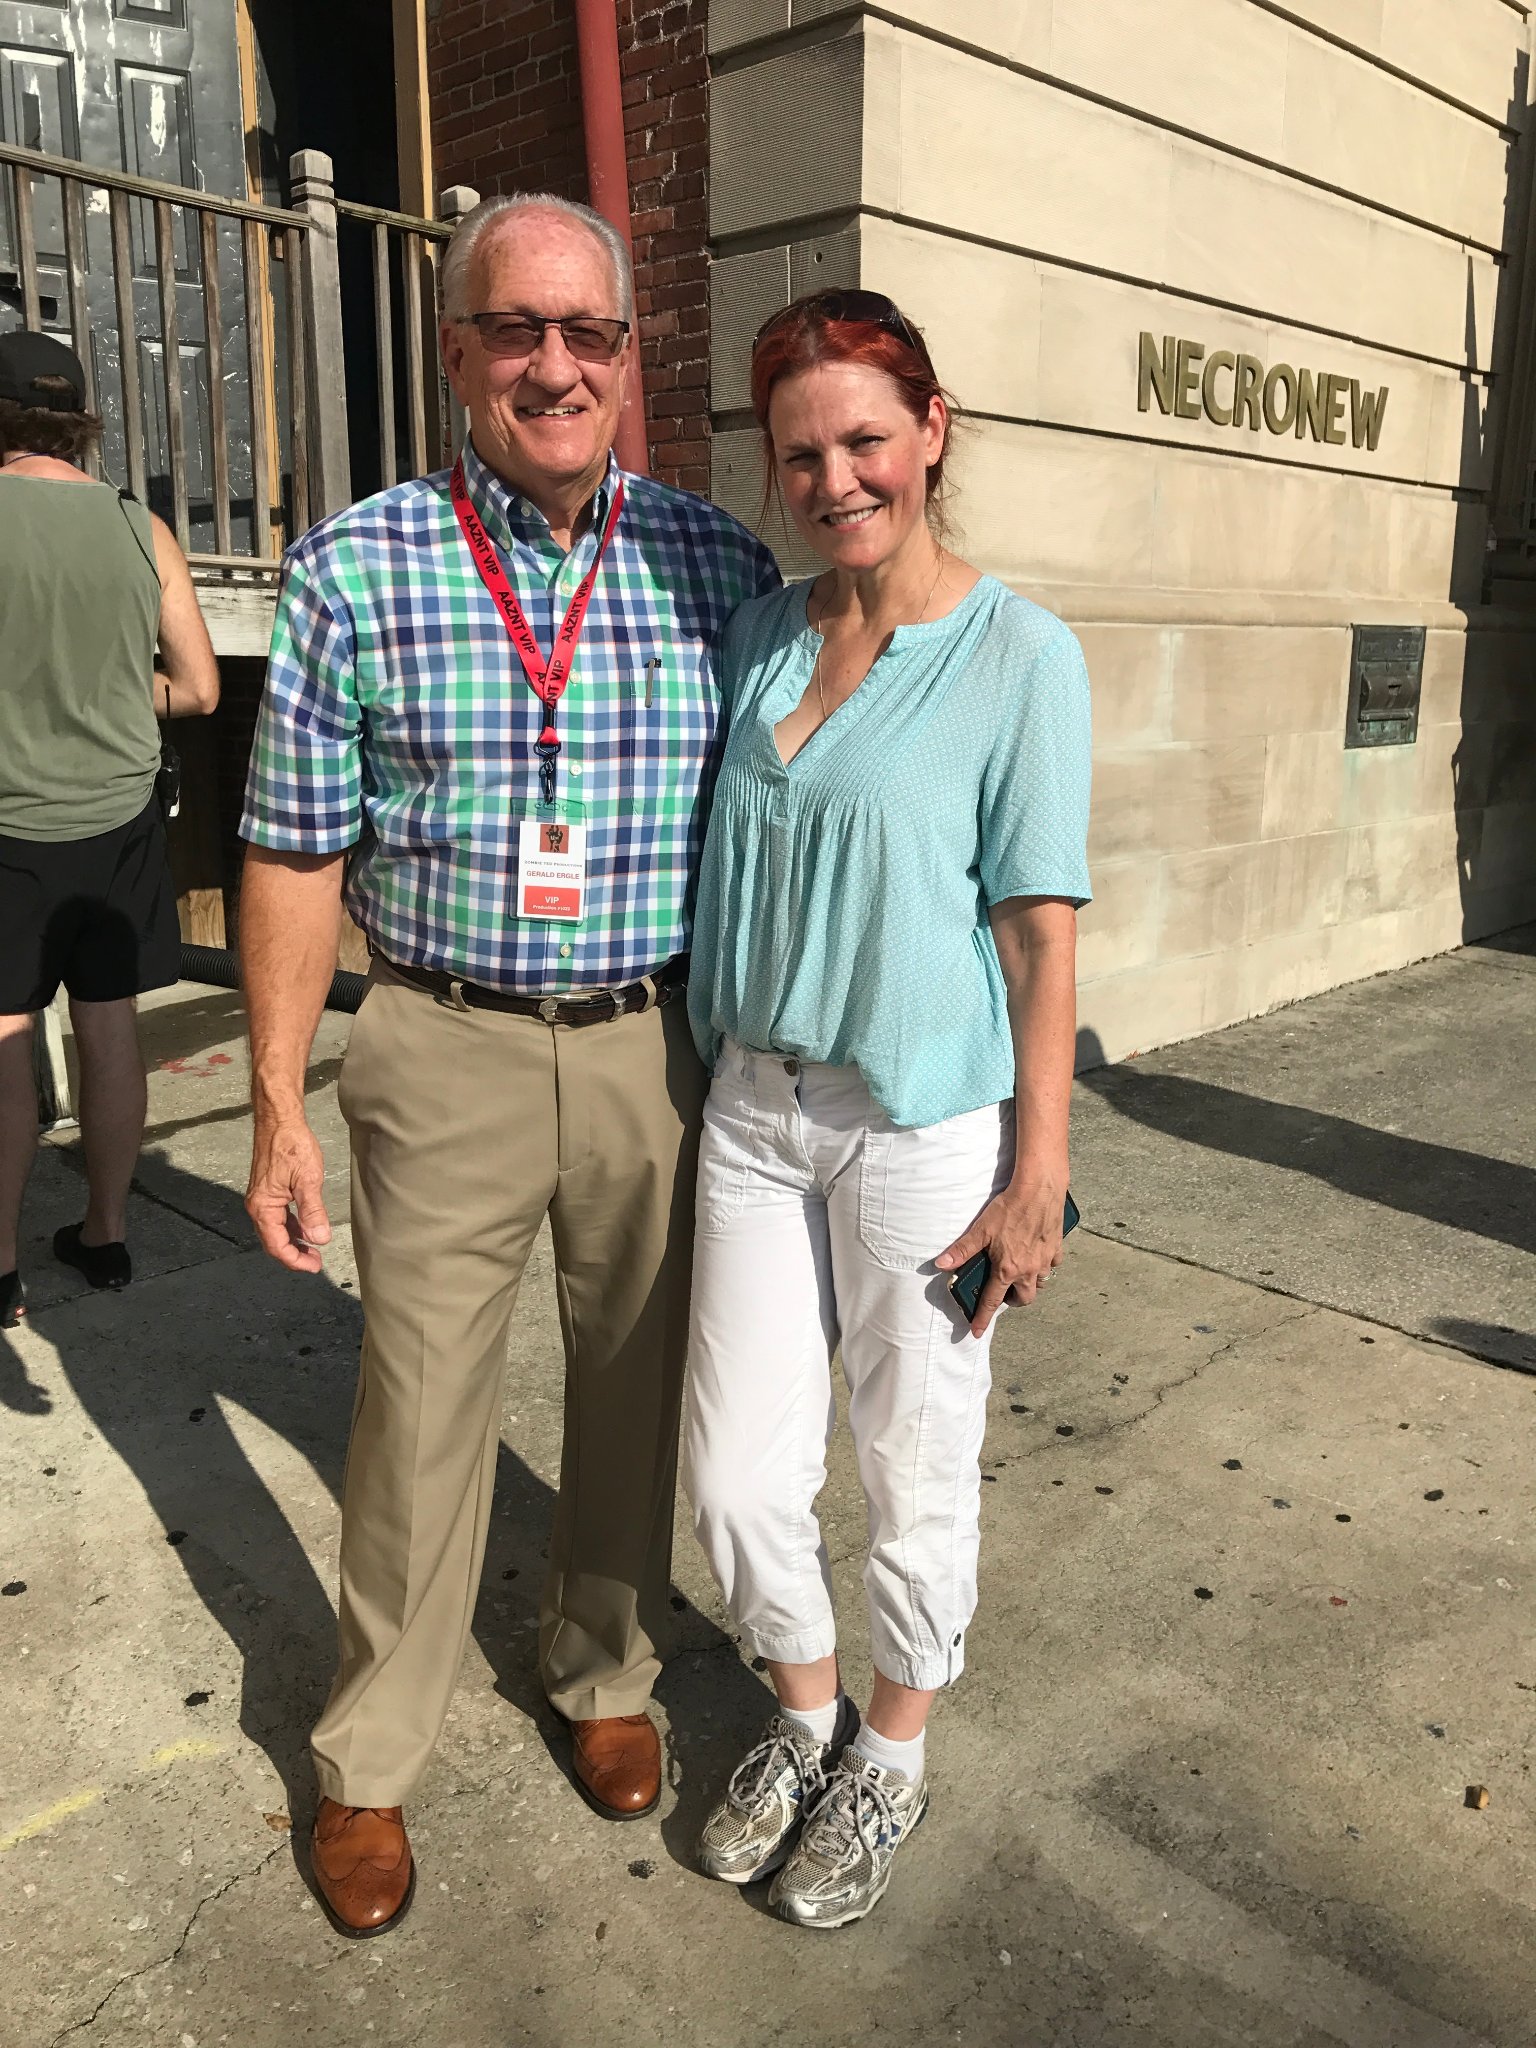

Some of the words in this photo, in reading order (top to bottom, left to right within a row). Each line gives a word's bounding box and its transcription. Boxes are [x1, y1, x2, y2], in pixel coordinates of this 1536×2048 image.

[1137, 331, 1389, 451] NECRONEW
[455, 482, 465, 500] VIP
[464, 514, 489, 553] AAZNT
[483, 554, 499, 575] VIP
[497, 591, 526, 631] AAZNT
[519, 633, 536, 654] VIP
[561, 602, 583, 643] AAZNT
[576, 581, 589, 599] VIP
[551, 660, 564, 683] VIP
[546, 684, 559, 710] ZNT
[526, 870, 555, 878] GERALD
[544, 895, 560, 904] VIP
